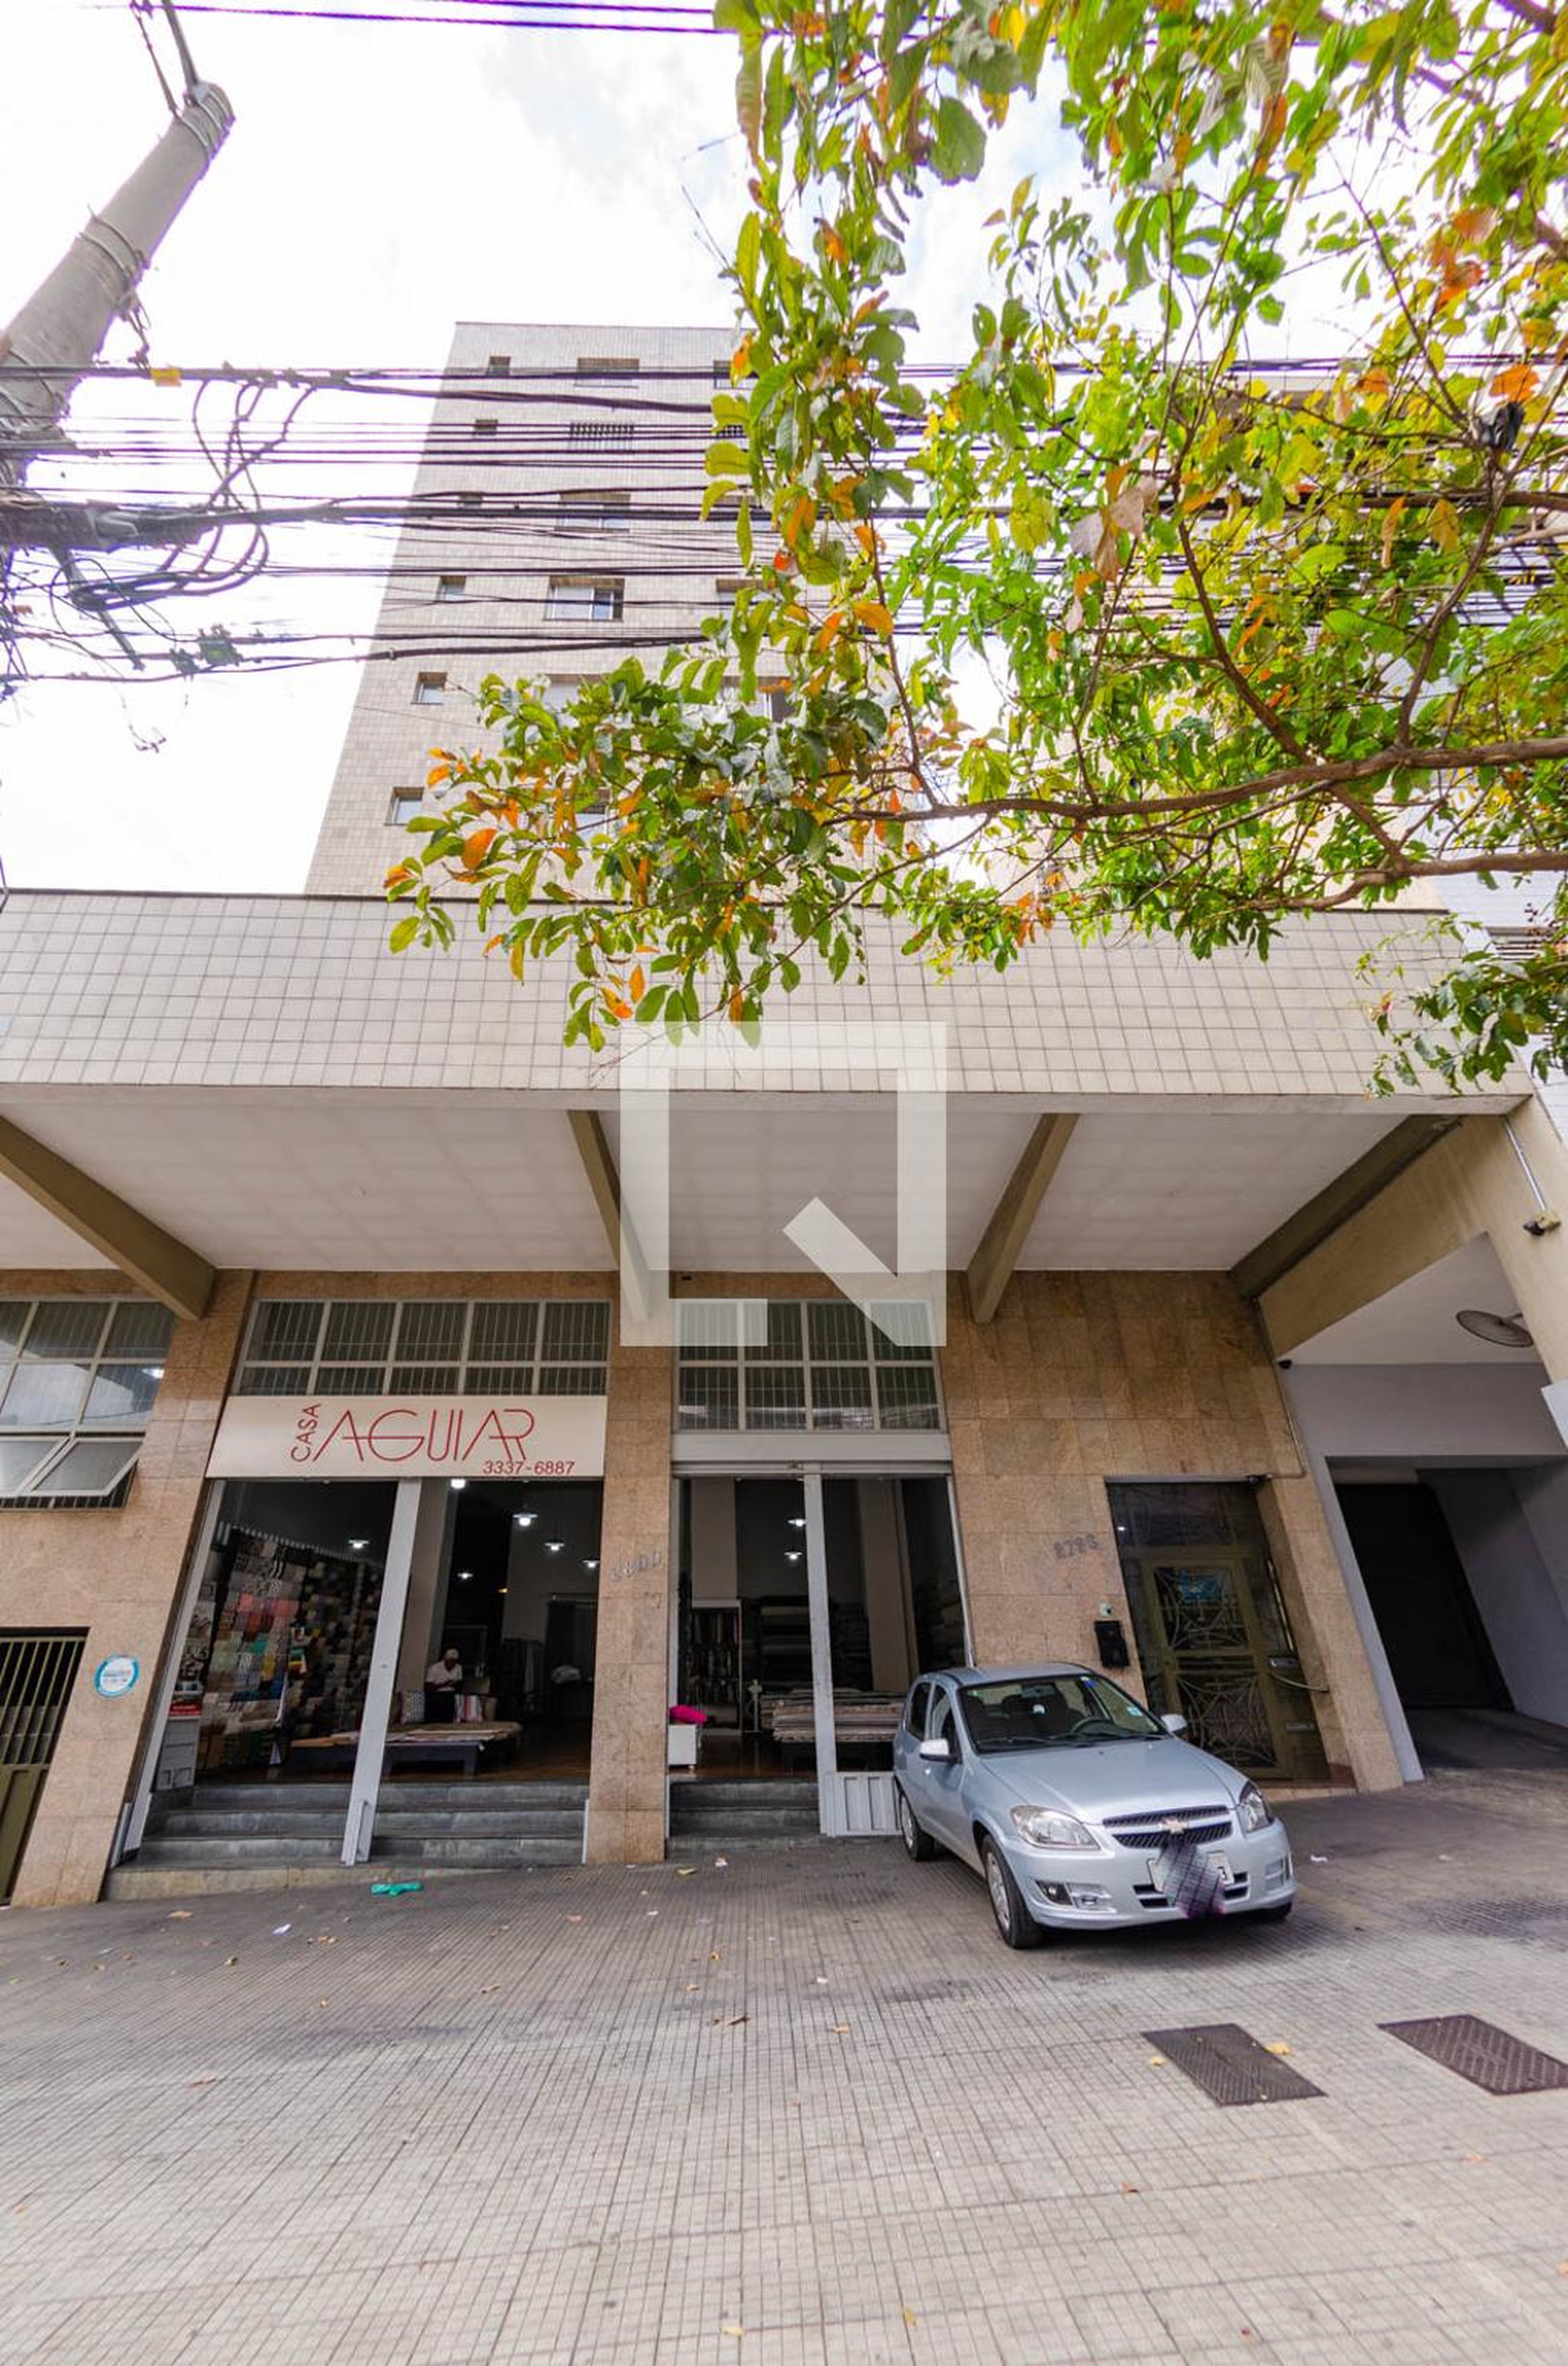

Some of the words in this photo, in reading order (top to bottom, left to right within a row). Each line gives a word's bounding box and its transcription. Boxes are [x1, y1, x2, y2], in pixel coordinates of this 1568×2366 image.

[291, 1404, 321, 1462] CASA
[312, 1408, 535, 1462] AGUIAR
[483, 1460, 575, 1475] 3337-6887
